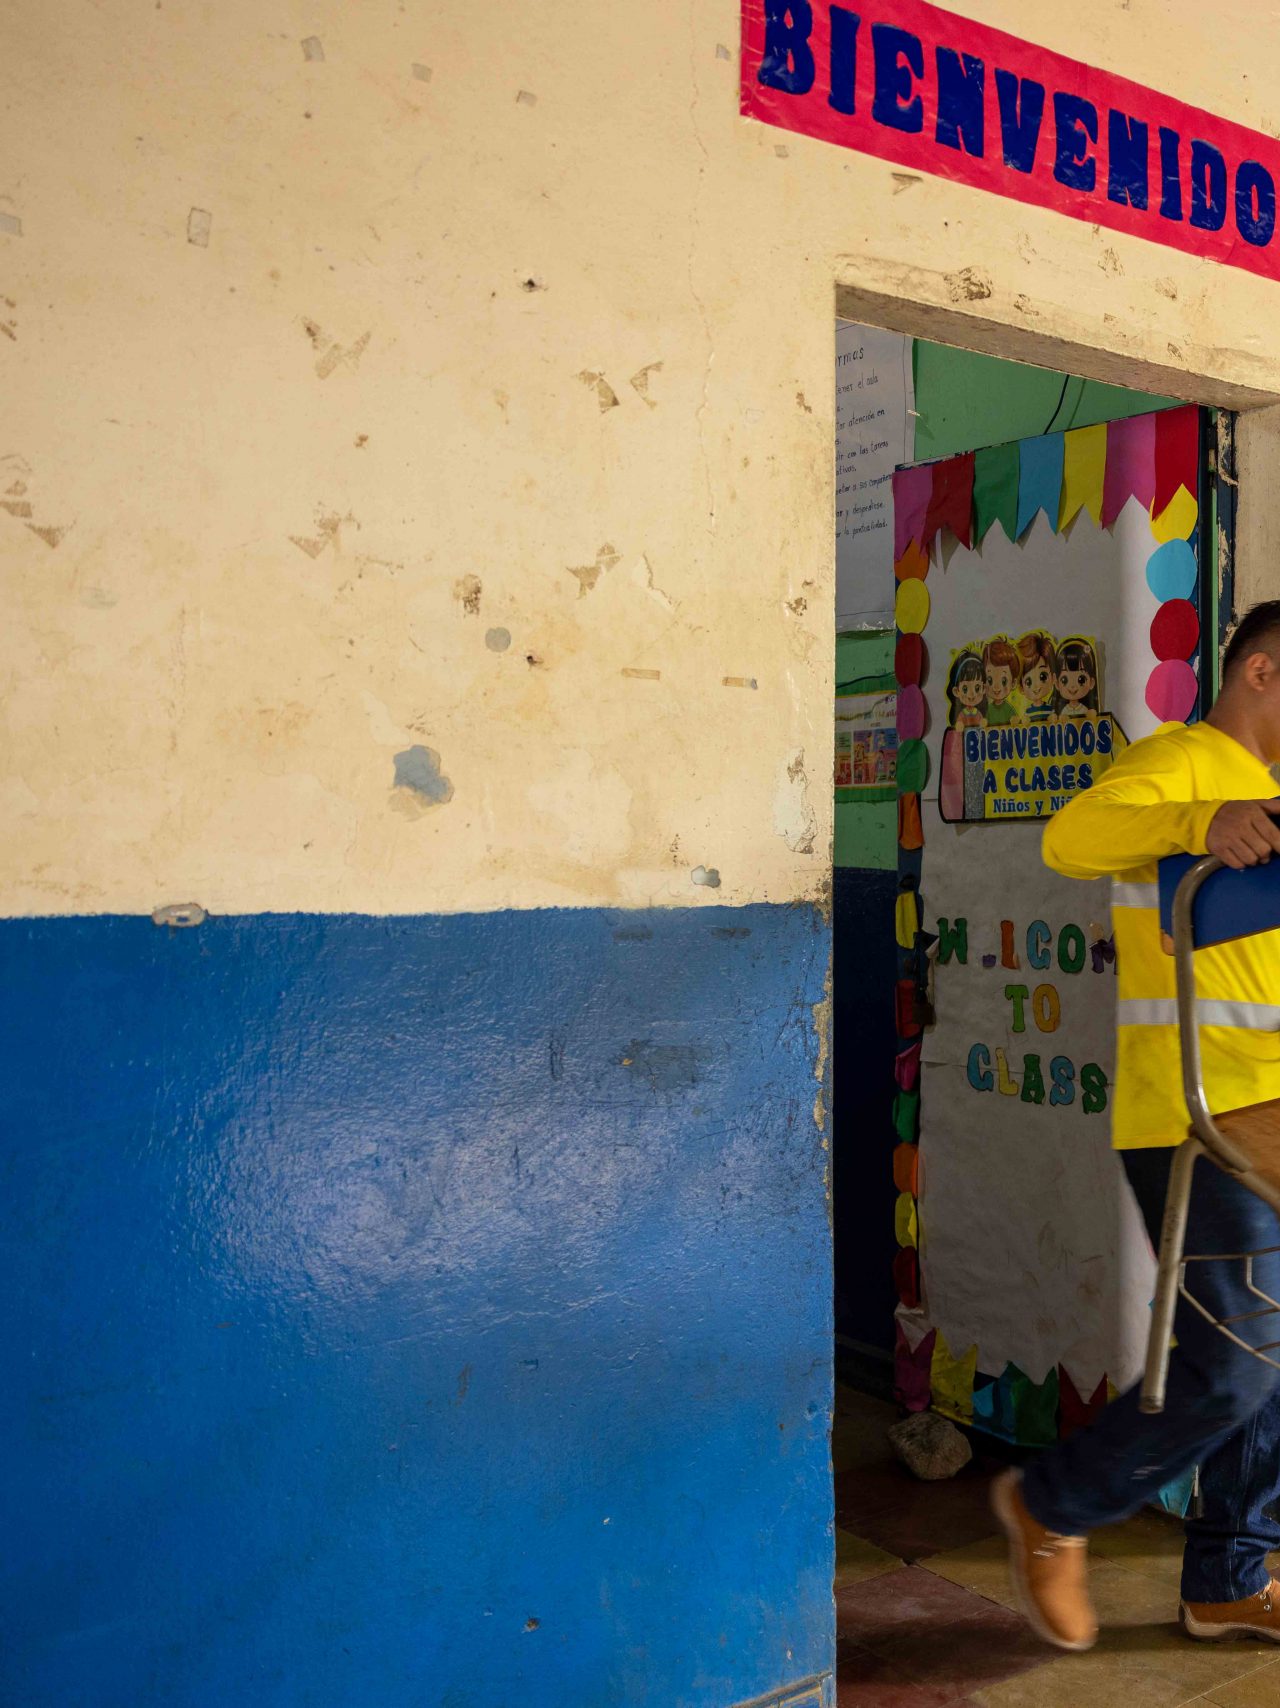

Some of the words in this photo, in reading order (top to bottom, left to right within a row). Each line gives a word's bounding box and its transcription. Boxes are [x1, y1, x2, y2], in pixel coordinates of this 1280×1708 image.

[837, 347, 864, 367] rmas
[857, 371, 864, 389] el
[876, 408, 885, 417] en
[965, 719, 1112, 764] BIENVENIDOS
[982, 768, 997, 794] A
[1004, 763, 1093, 794] CLASES
[993, 797, 1030, 813] Niños
[1034, 800, 1044, 817] y
[1050, 796, 1073, 812] Niñ
[1004, 983, 1061, 1033] TO
[967, 1042, 1108, 1115] CLASS
